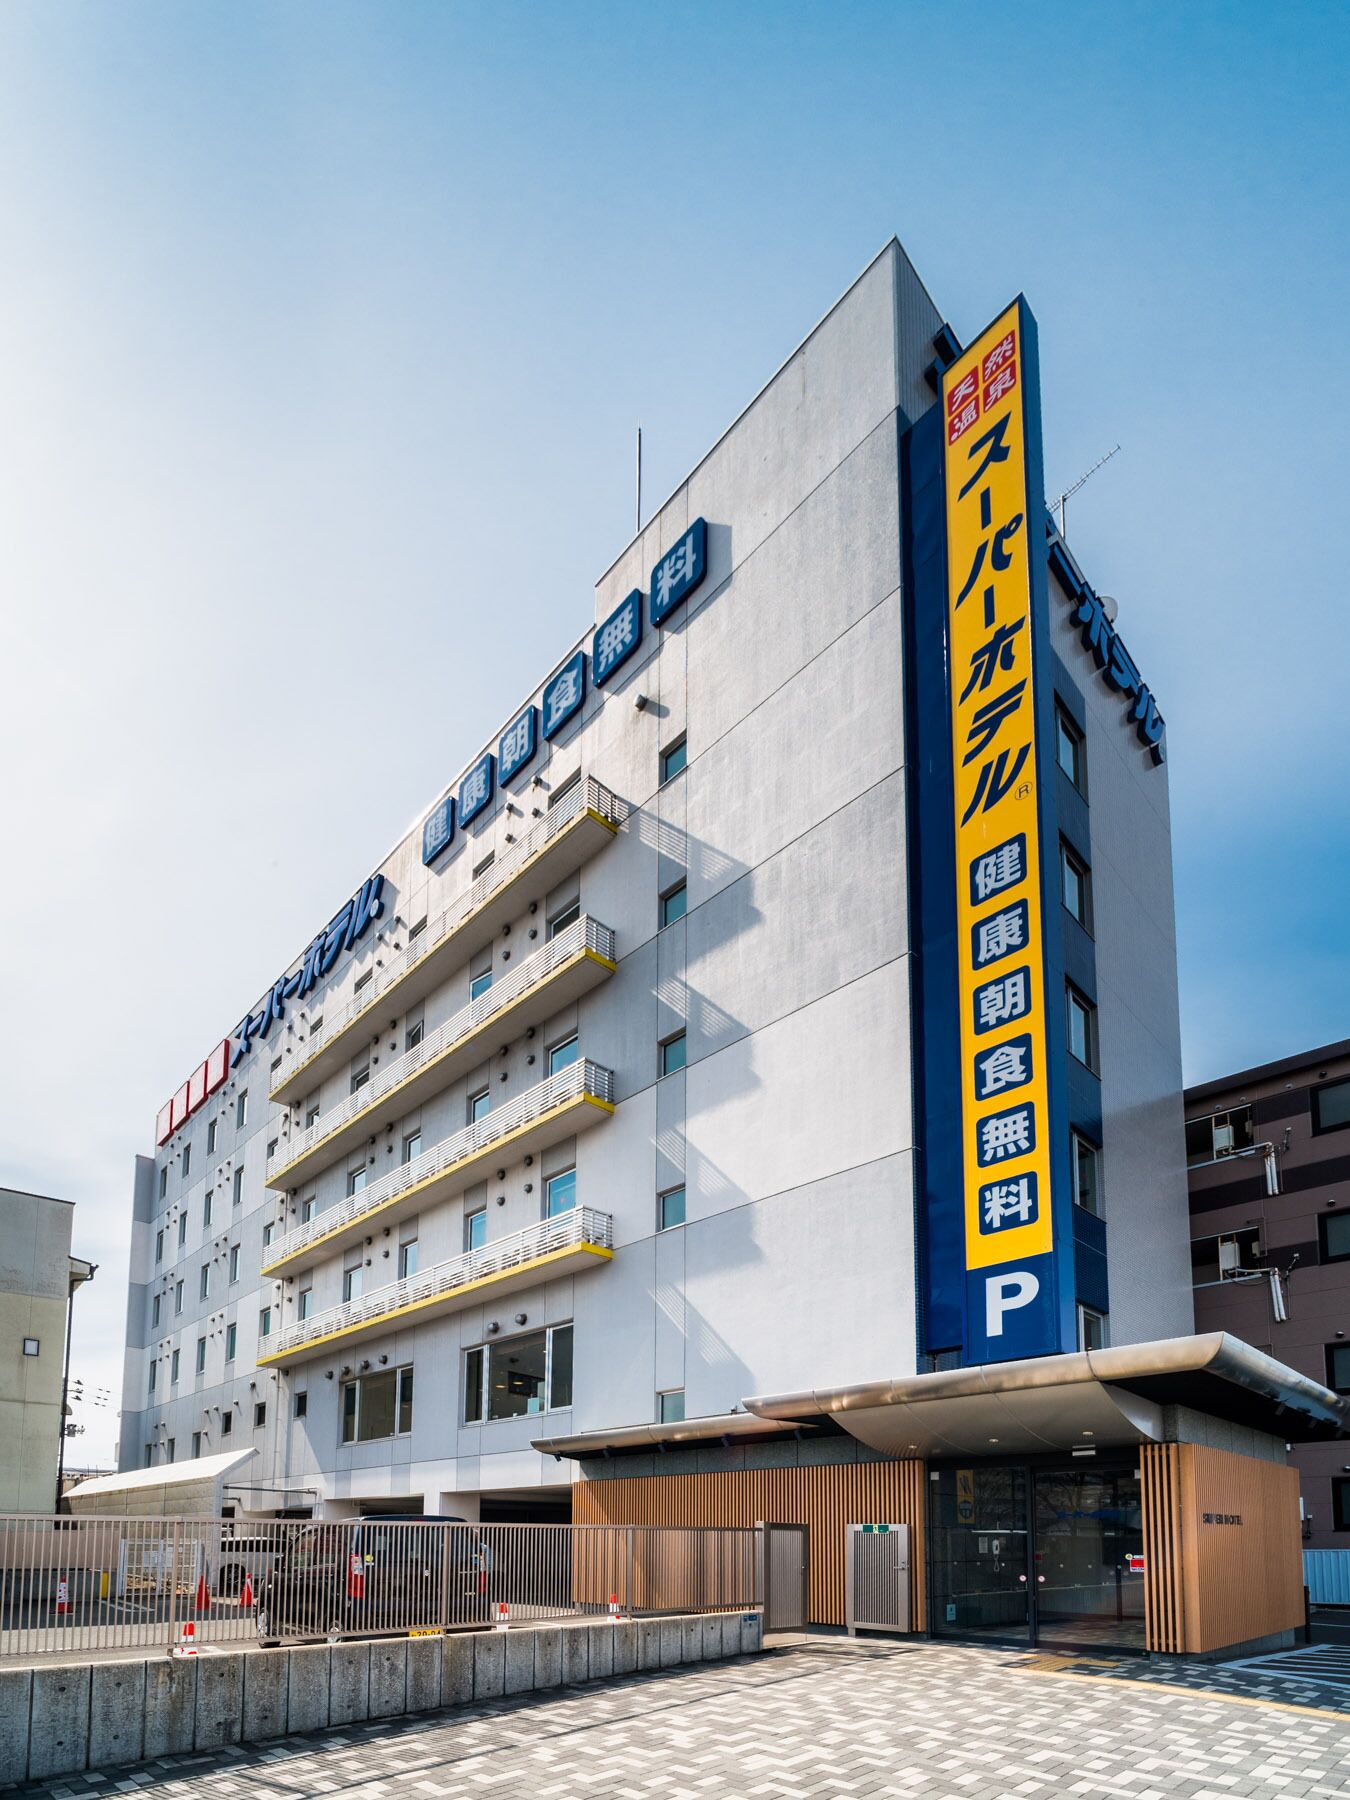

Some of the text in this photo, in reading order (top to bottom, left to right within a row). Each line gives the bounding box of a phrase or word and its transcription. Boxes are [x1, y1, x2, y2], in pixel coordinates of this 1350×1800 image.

[426, 533, 697, 856] 健康朝食無料
[955, 412, 1033, 827] スーパーホテル
[231, 873, 386, 1069] スーパーホテル
[974, 839, 1033, 1230] 健康朝食無料
[985, 1271, 1040, 1338] P
